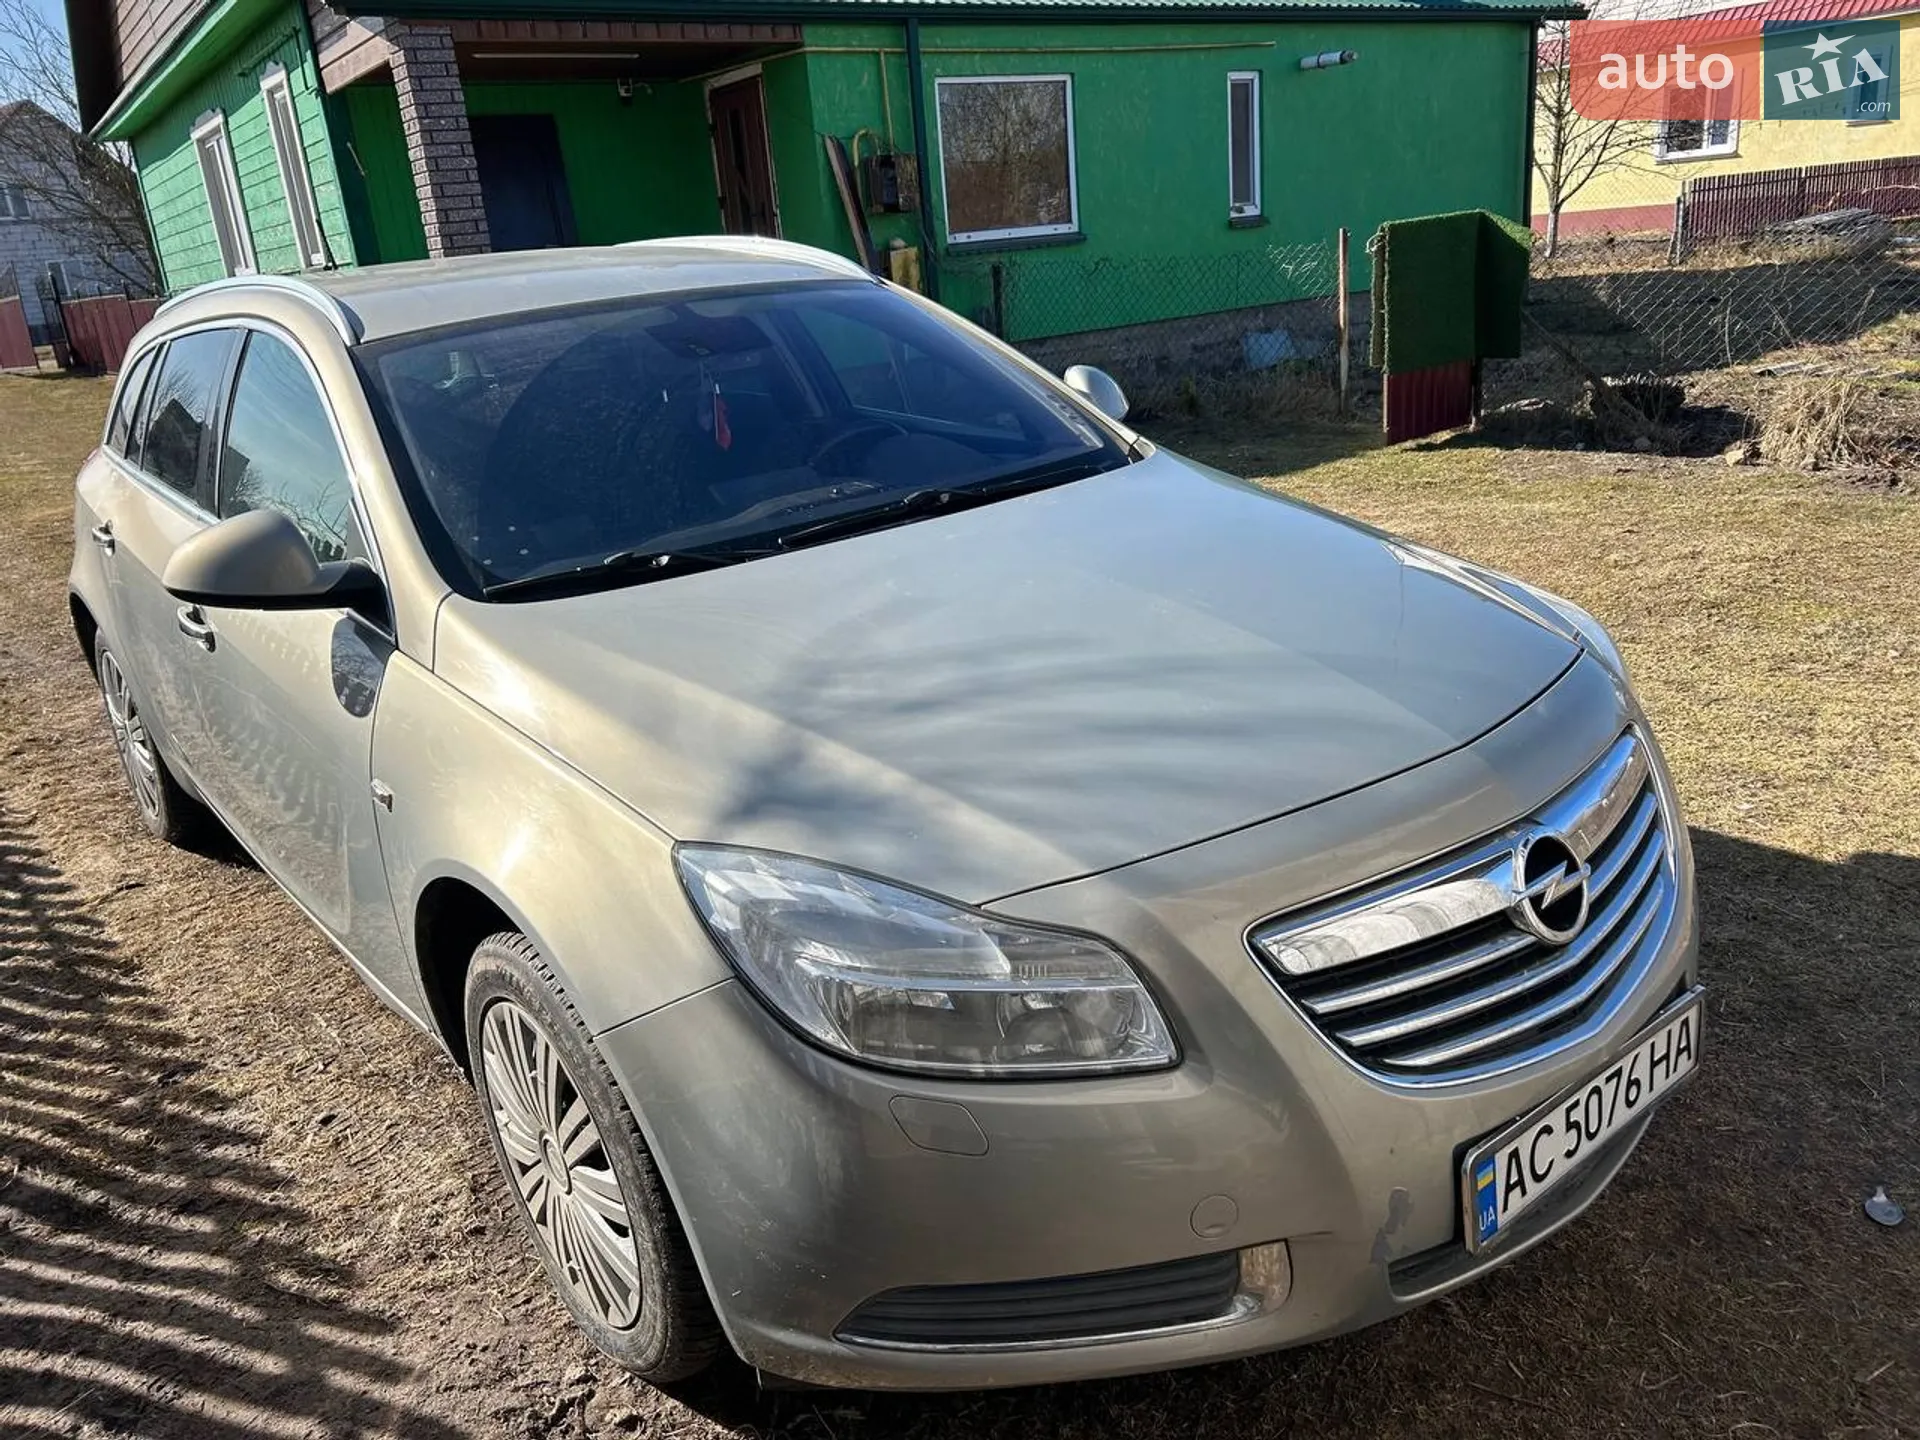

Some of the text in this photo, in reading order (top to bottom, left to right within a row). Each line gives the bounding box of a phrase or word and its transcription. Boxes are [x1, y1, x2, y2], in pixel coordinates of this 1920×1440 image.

[1502, 1016, 1691, 1213] AC 5076 HA
[1479, 1205, 1496, 1231] UA
